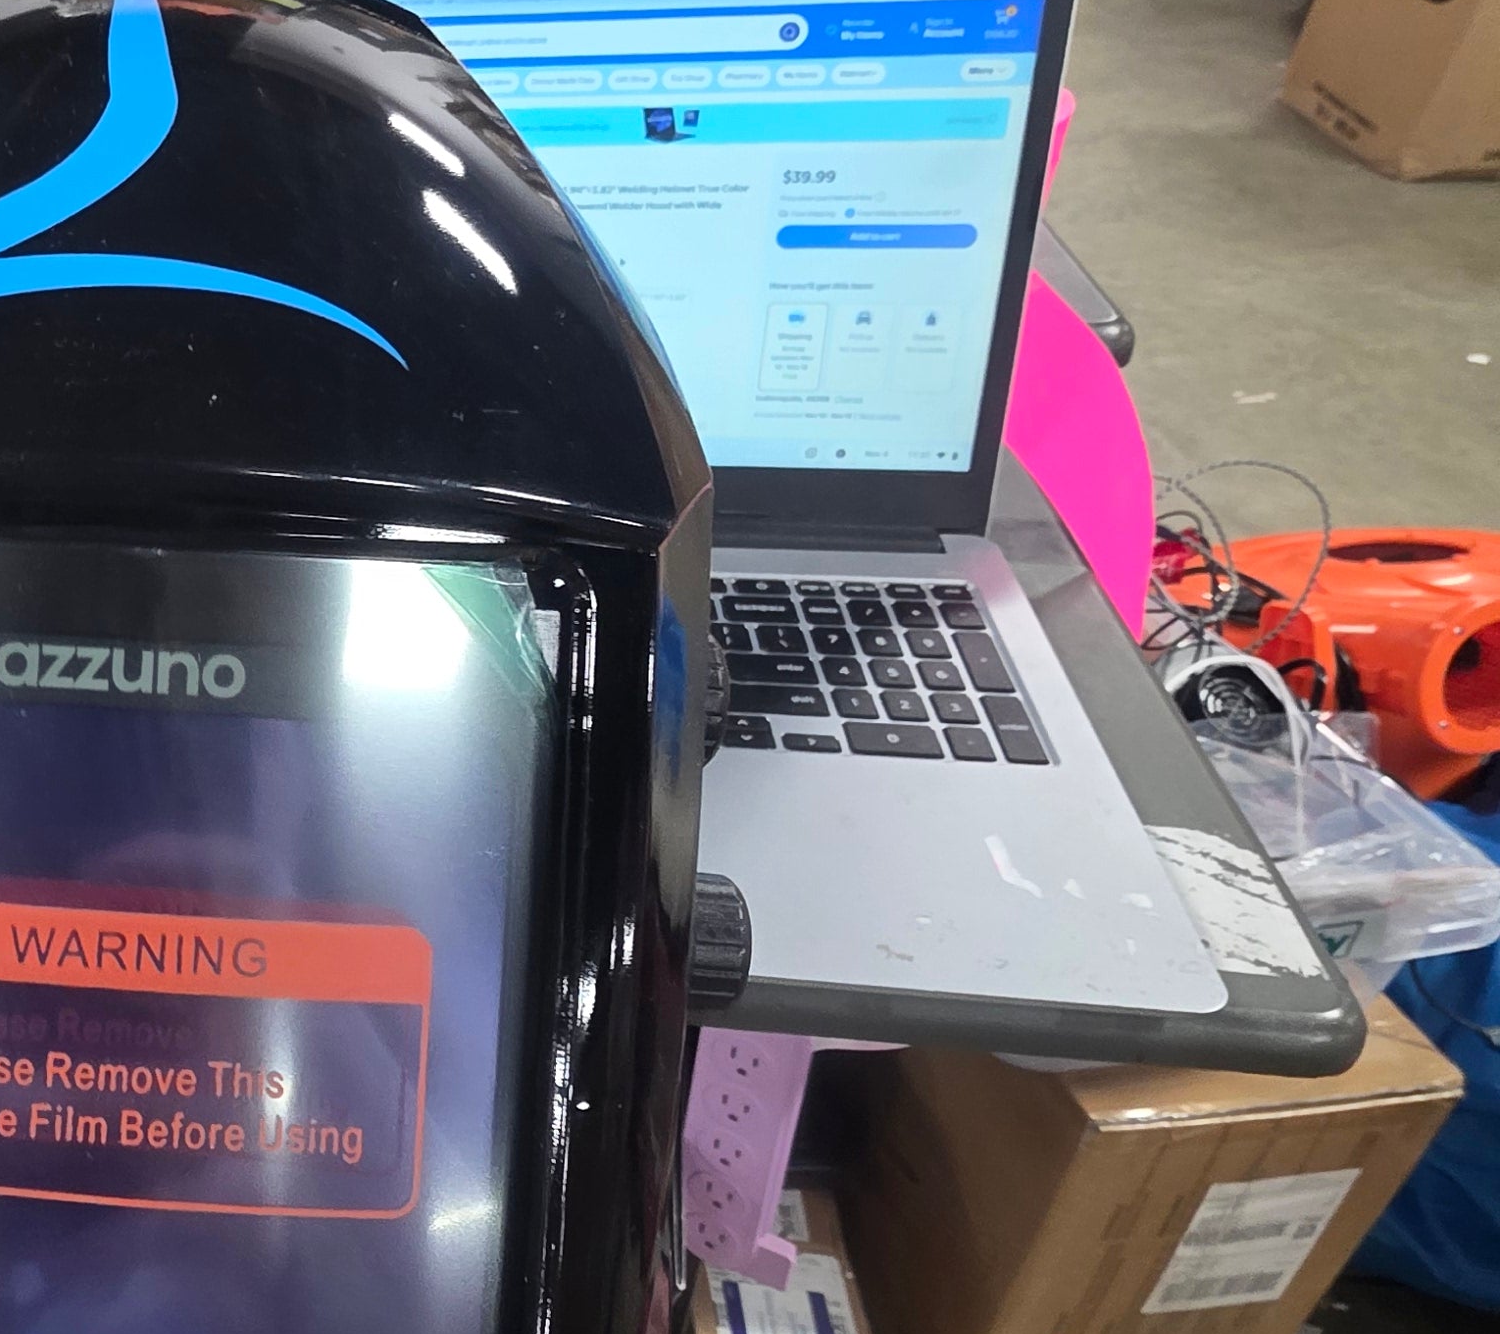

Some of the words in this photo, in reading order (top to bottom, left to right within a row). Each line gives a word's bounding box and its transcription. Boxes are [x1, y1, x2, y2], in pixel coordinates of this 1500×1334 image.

[783, 169, 837, 186] $39.99
[839, 666, 850, 676] 4
[900, 700, 912, 710] 2
[950, 703, 962, 712] 3
[10, 923, 269, 979] WARNING
[45, 1050, 198, 1098] Remove
[206, 1060, 285, 1101] This
[28, 1102, 108, 1145] Film
[118, 1109, 245, 1153] Before
[257, 1115, 364, 1166] Using
